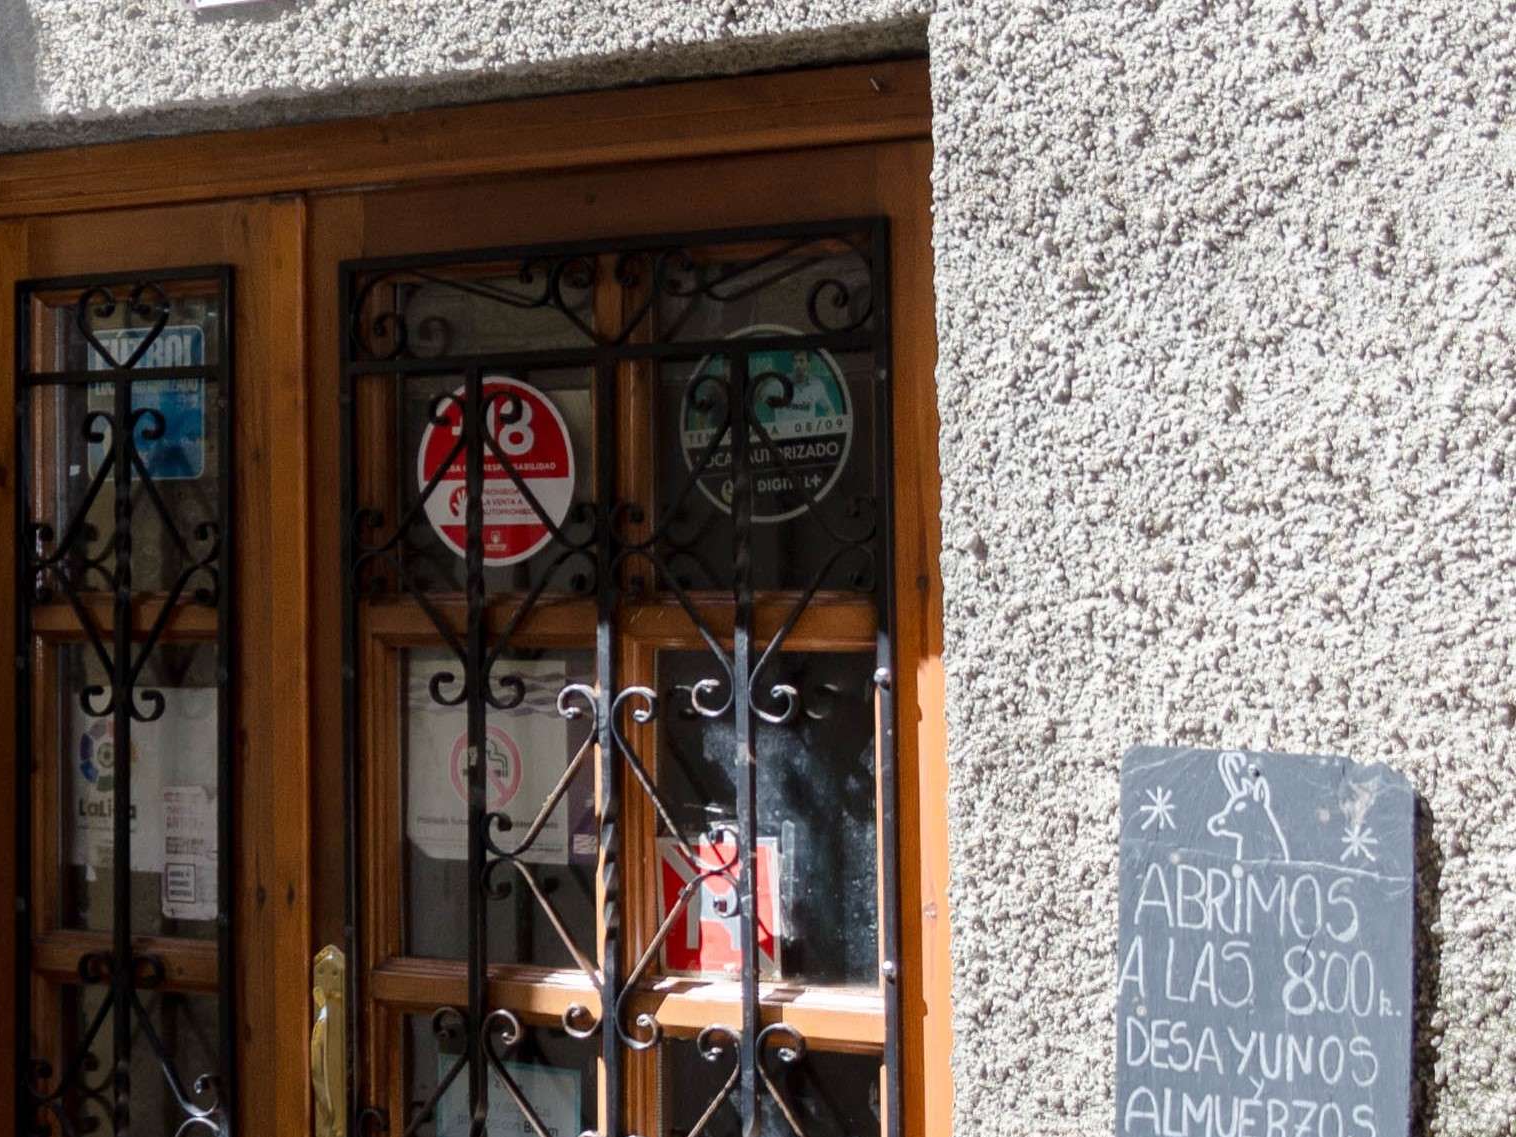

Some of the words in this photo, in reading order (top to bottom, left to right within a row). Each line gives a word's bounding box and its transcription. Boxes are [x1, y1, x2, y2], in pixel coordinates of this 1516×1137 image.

[79, 798, 137, 819] LaLia
[1133, 861, 1360, 944] ABRIMOS
[1117, 935, 1147, 999] A
[1164, 937, 1256, 1009] LAS
[1125, 1015, 1378, 1087] DESAYUNOS
